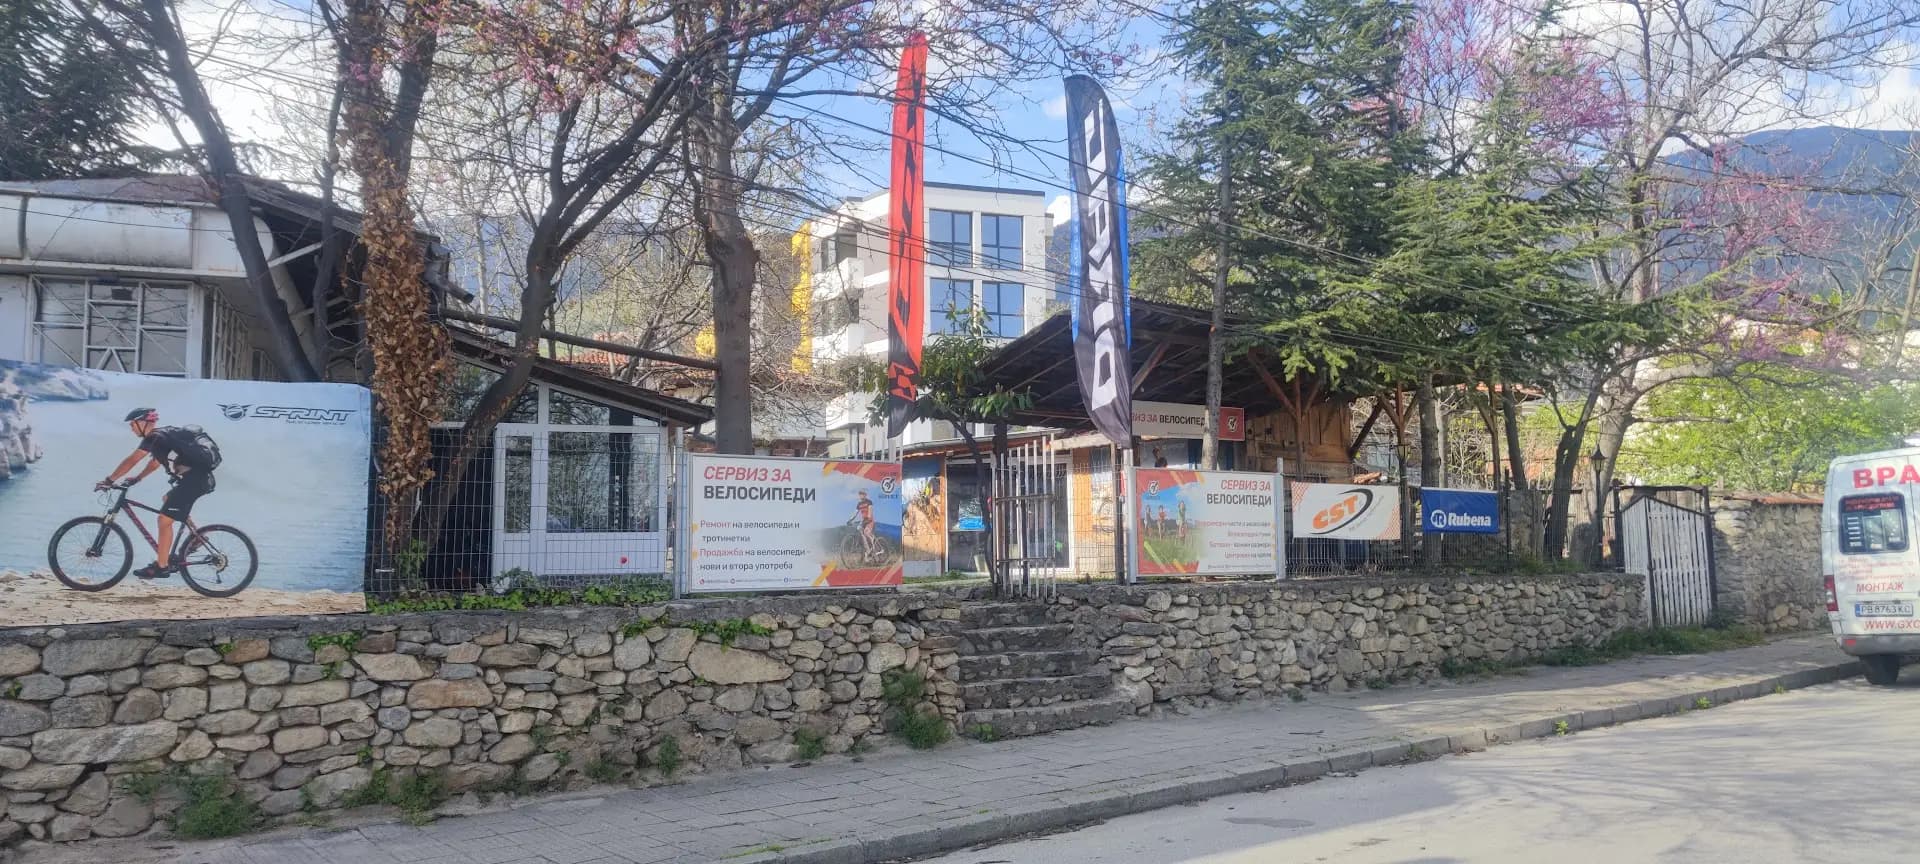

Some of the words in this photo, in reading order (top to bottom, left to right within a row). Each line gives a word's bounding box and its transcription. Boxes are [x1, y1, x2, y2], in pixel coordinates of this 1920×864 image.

[250, 406, 357, 421] SPRINT
[1146, 413, 1158, 424] ЗА
[704, 466, 768, 482] СЕРВИЗ
[771, 468, 792, 482] ЗА
[1221, 479, 1258, 490] СЕРВИЗ
[1259, 480, 1271, 491] ЗА
[703, 485, 816, 503] ВЕЛОСИПЕДИ
[1206, 493, 1272, 507] ВЕЛОСИПЕДИ
[1312, 494, 1359, 530] CST
[700, 519, 732, 529] Ремонт
[733, 521, 743, 529] на
[744, 521, 794, 529] велосипеди
[794, 521, 800, 529] и
[1448, 512, 1492, 527] Rubena
[702, 535, 751, 543] тротинетки
[700, 548, 744, 557] Продажба
[756, 549, 806, 557] велосипеди
[701, 563, 721, 571] нови
[729, 562, 754, 571] втора
[756, 560, 793, 571] употреба
[1856, 581, 1904, 592] МОНТАЖ
